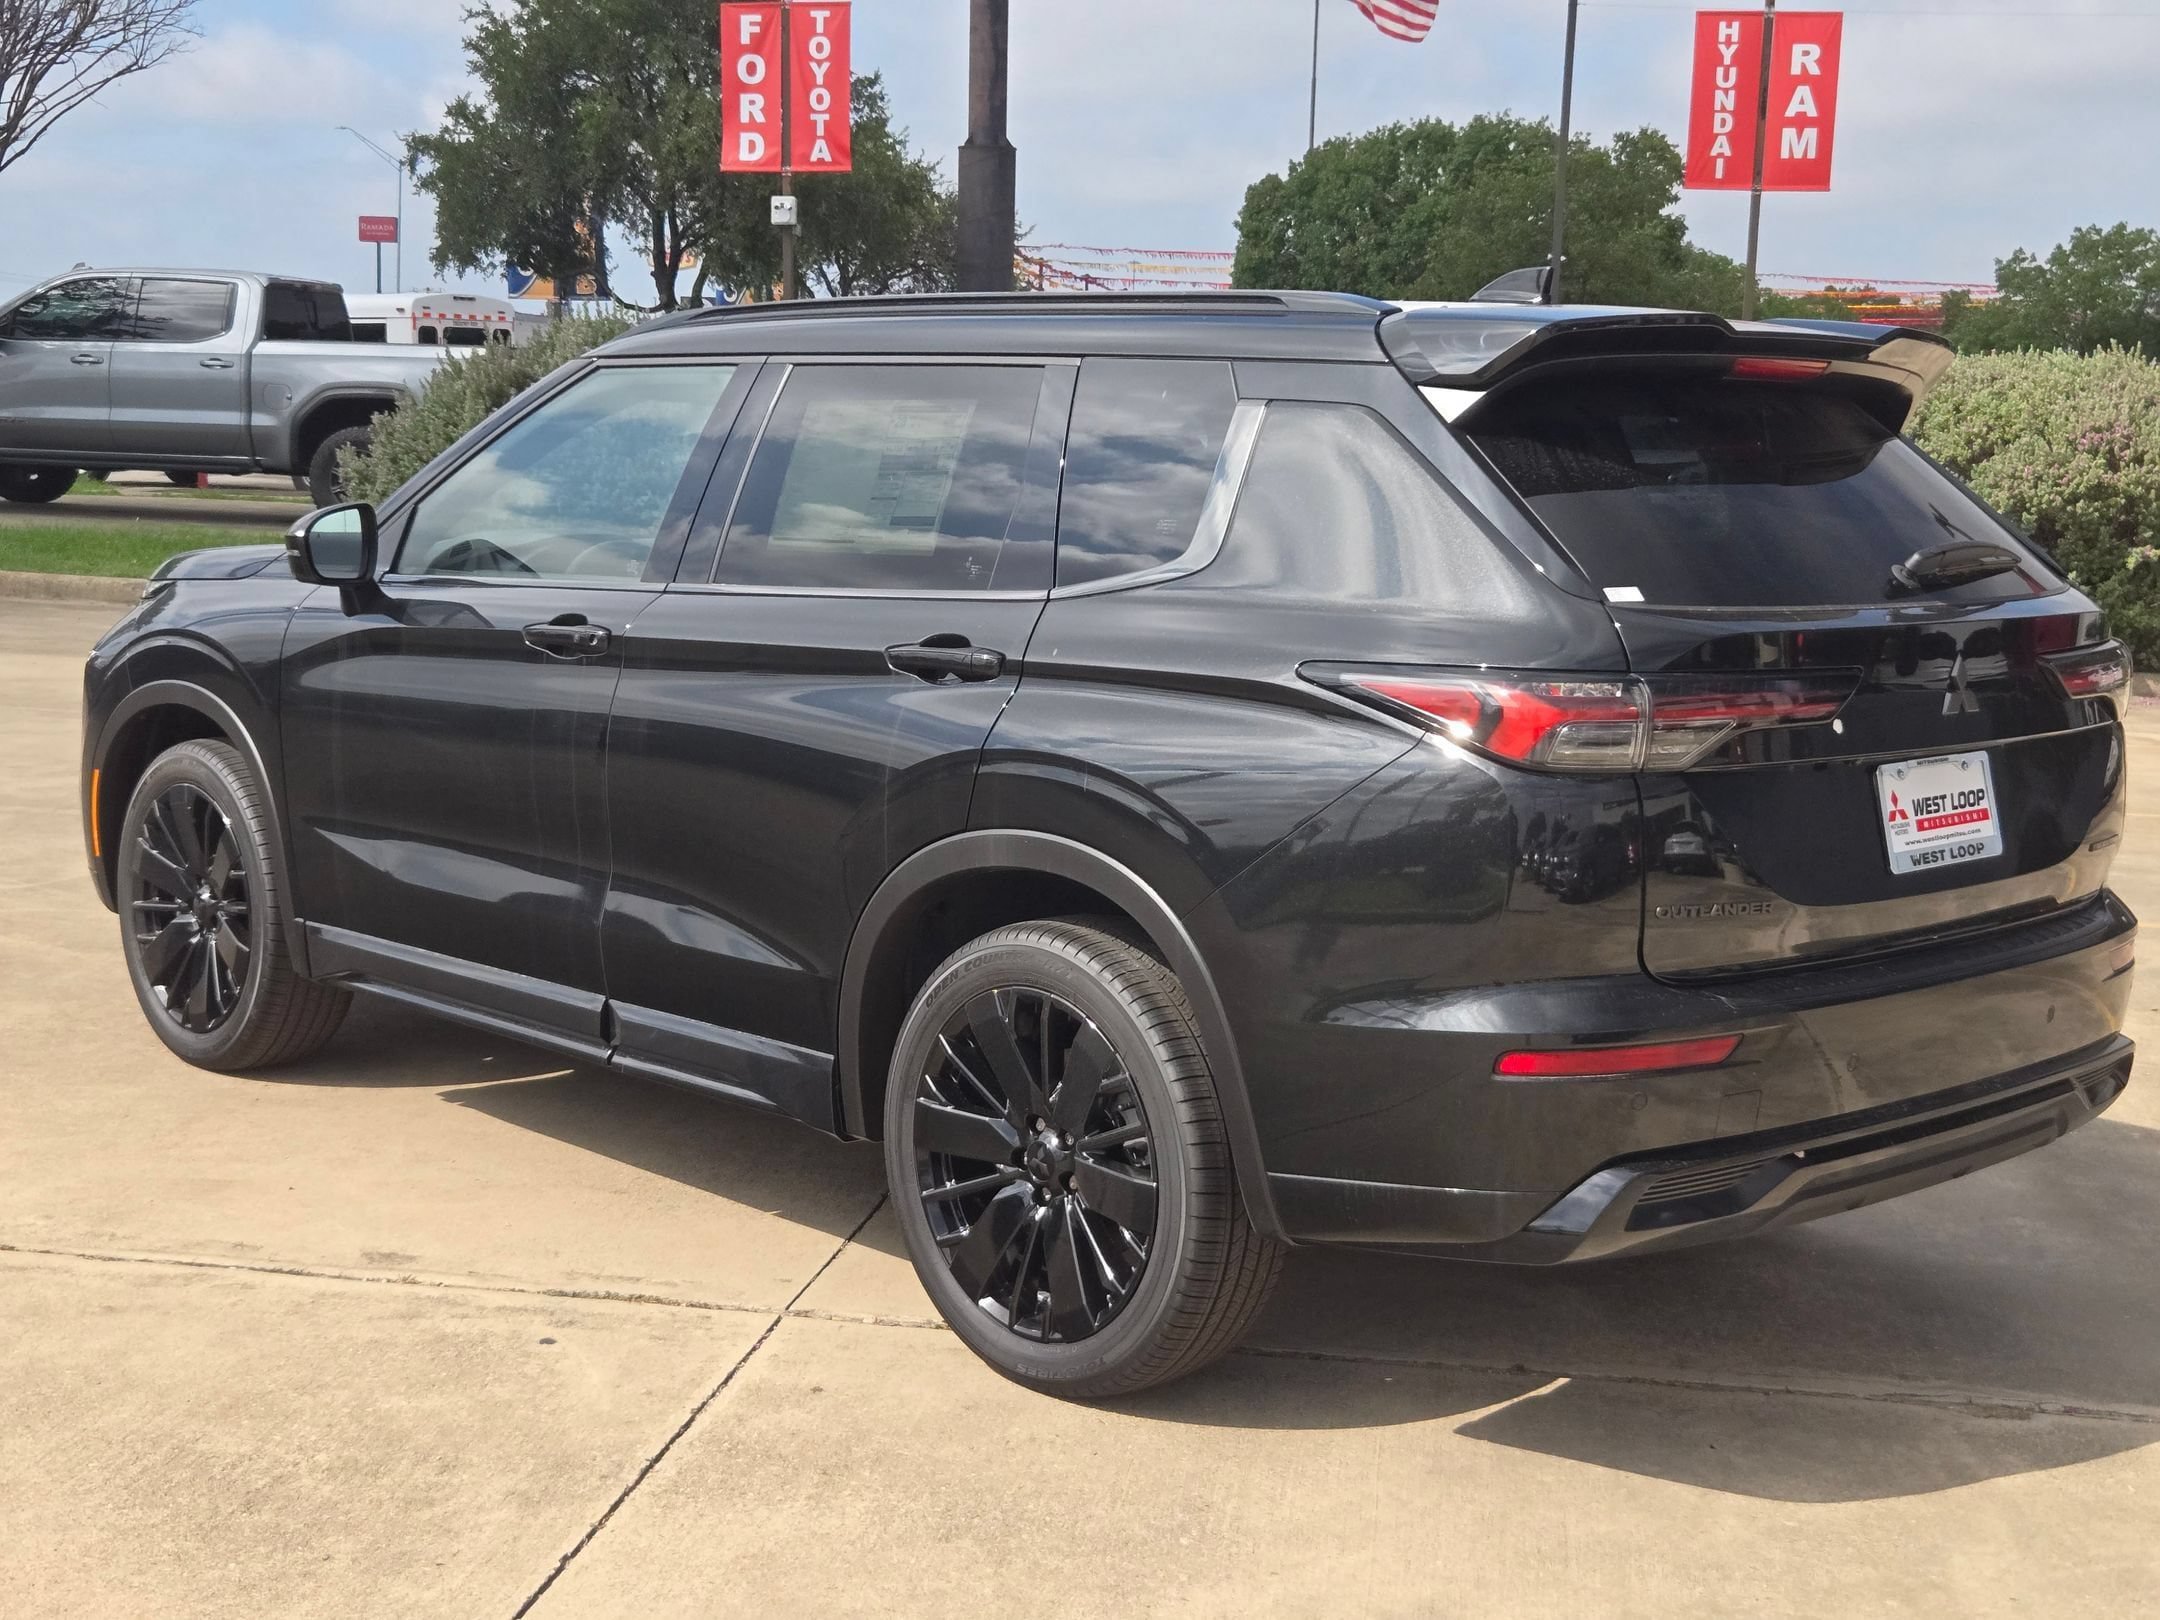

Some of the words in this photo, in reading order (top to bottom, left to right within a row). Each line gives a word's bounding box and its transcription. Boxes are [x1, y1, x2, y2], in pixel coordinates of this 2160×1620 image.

[736, 14, 767, 162] FORD
[808, 10, 833, 163] TOYOTA
[1709, 21, 1740, 179] HYUNDAI
[1780, 43, 1822, 160] RAM
[361, 222, 394, 231] RAMADA
[1912, 794, 1947, 816] WEST
[1951, 788, 1985, 811] LOOP
[1922, 811, 1984, 829] MITSUBISHI
[1909, 850, 1946, 867] WEST
[1950, 842, 1985, 860] LOOP
[1655, 901, 1774, 920] OUTLANDER
[925, 972, 960, 1008] OPEN
